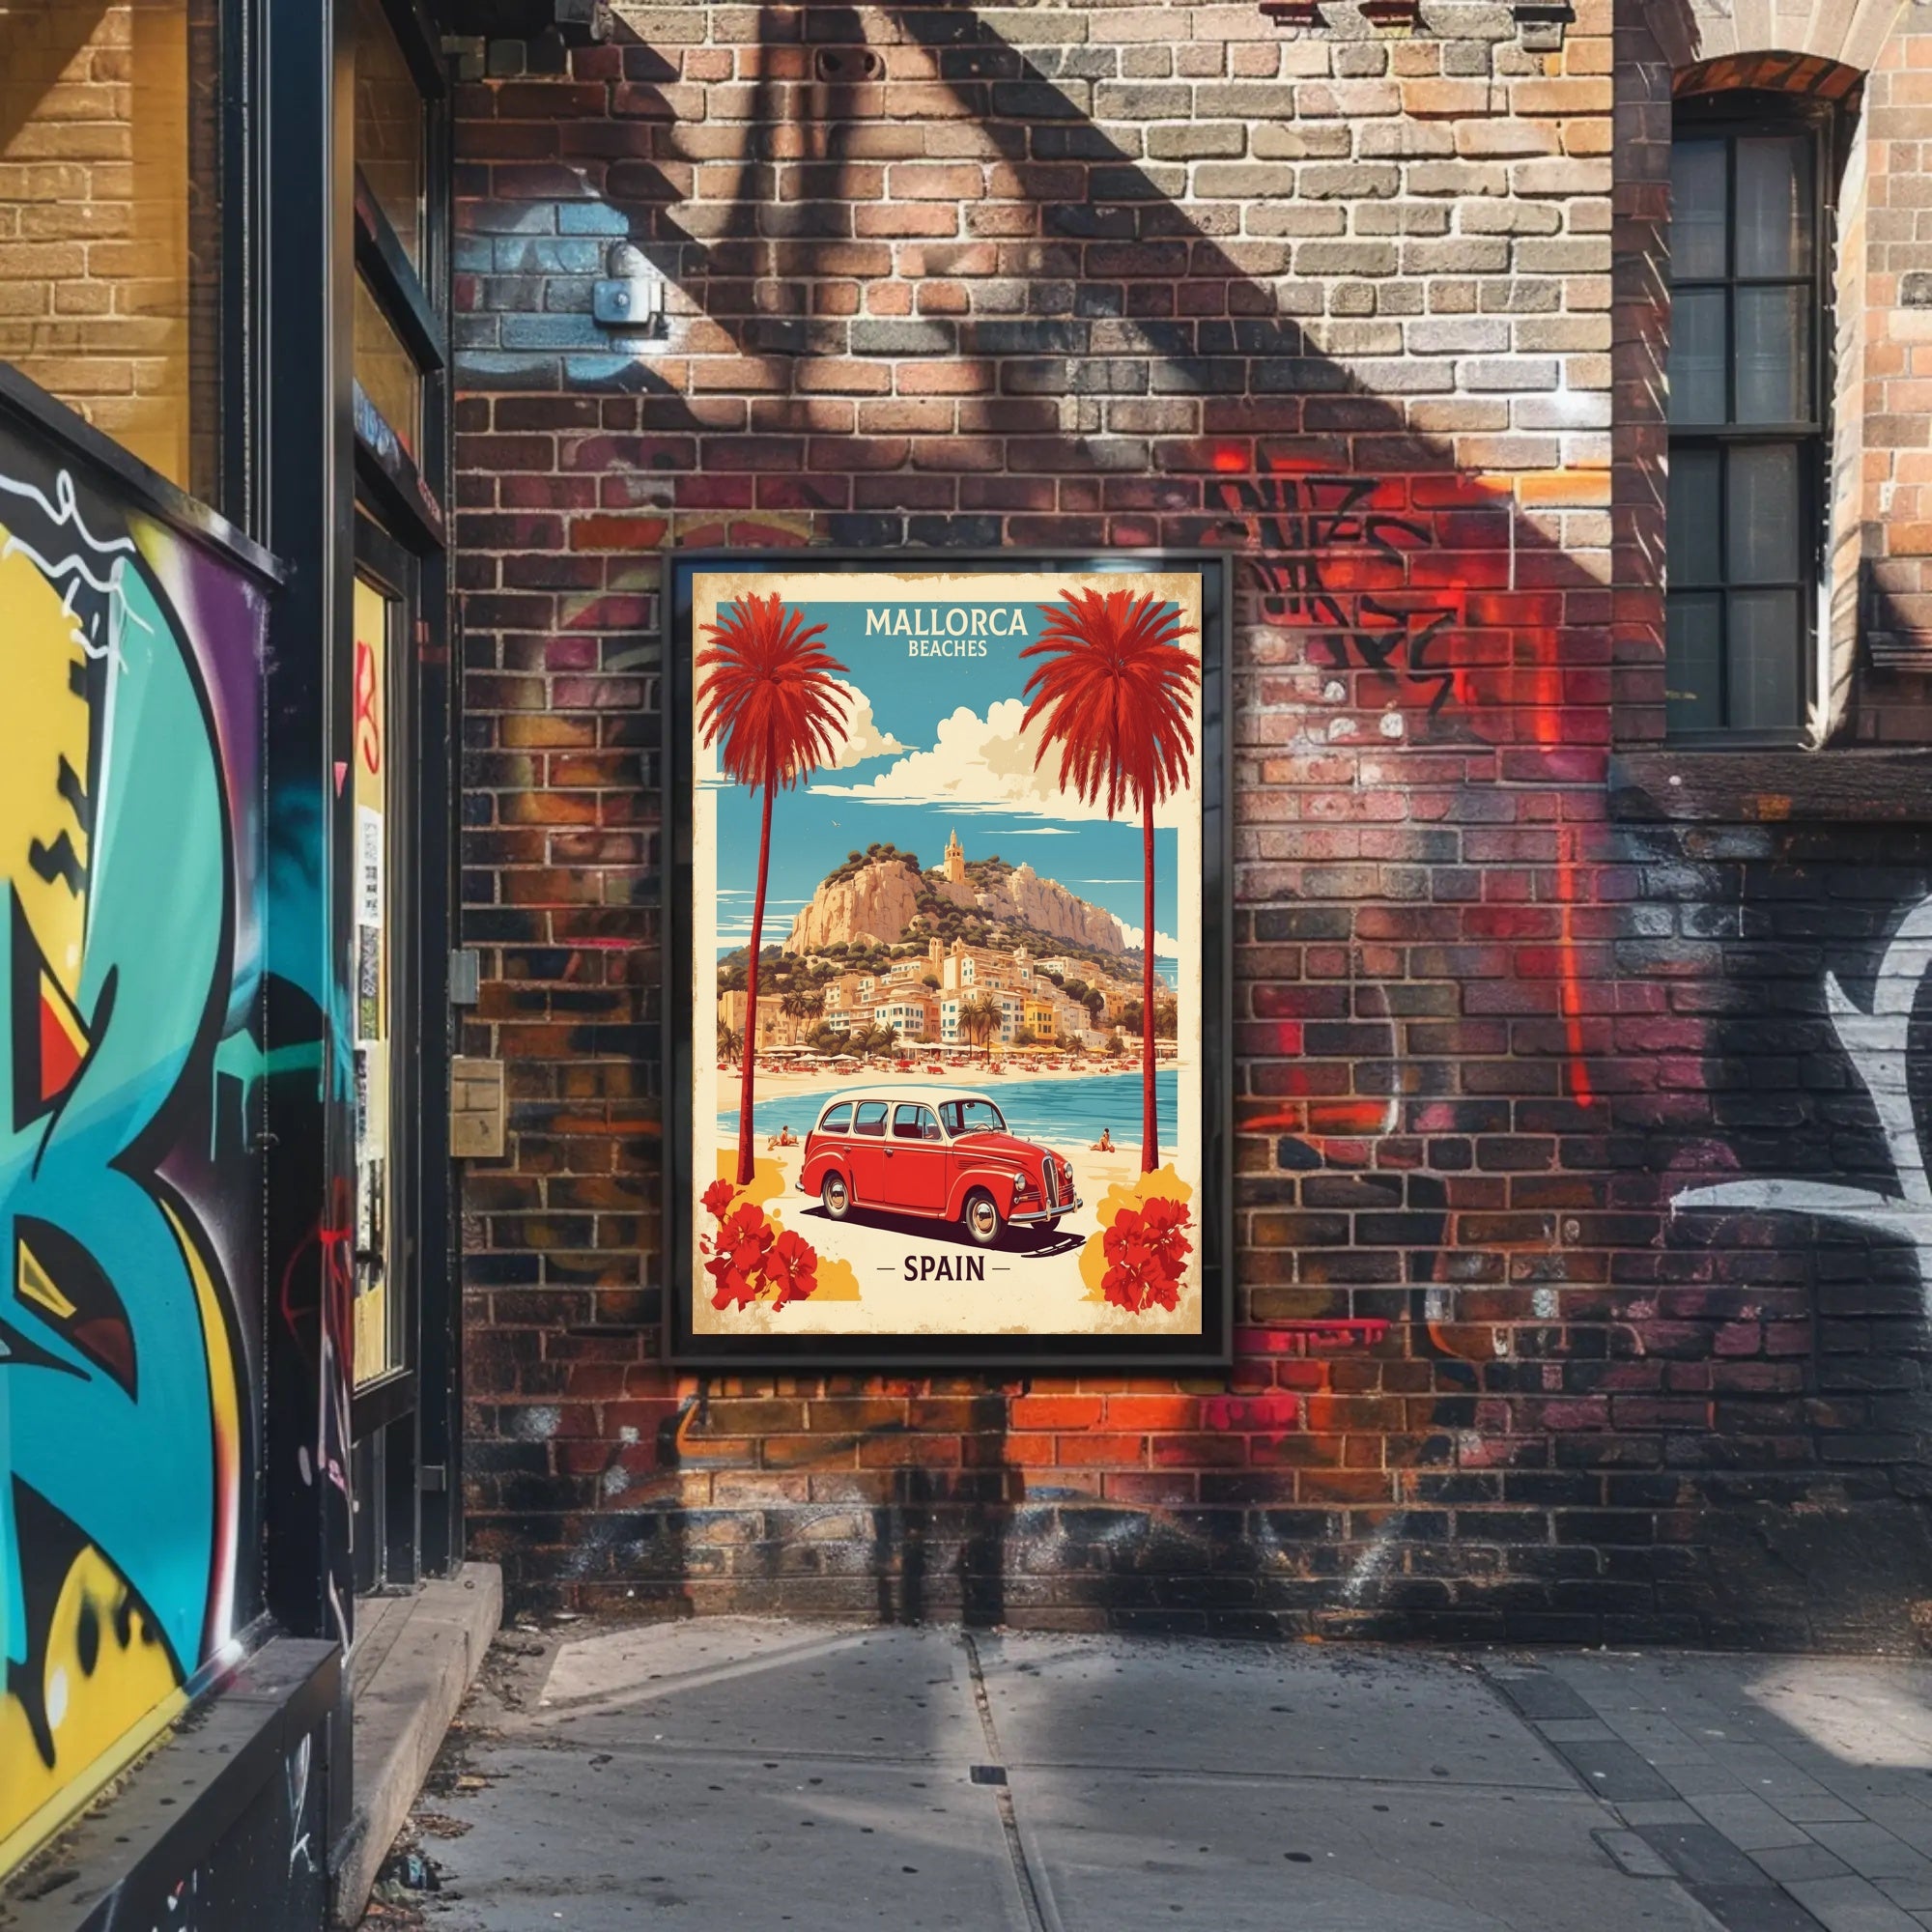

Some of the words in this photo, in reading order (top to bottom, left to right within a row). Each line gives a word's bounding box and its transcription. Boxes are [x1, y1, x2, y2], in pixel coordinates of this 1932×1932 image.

[865, 608, 1029, 637] MALLORCA
[908, 639, 987, 657] BEACHES
[904, 1255, 985, 1282] SPAIN
